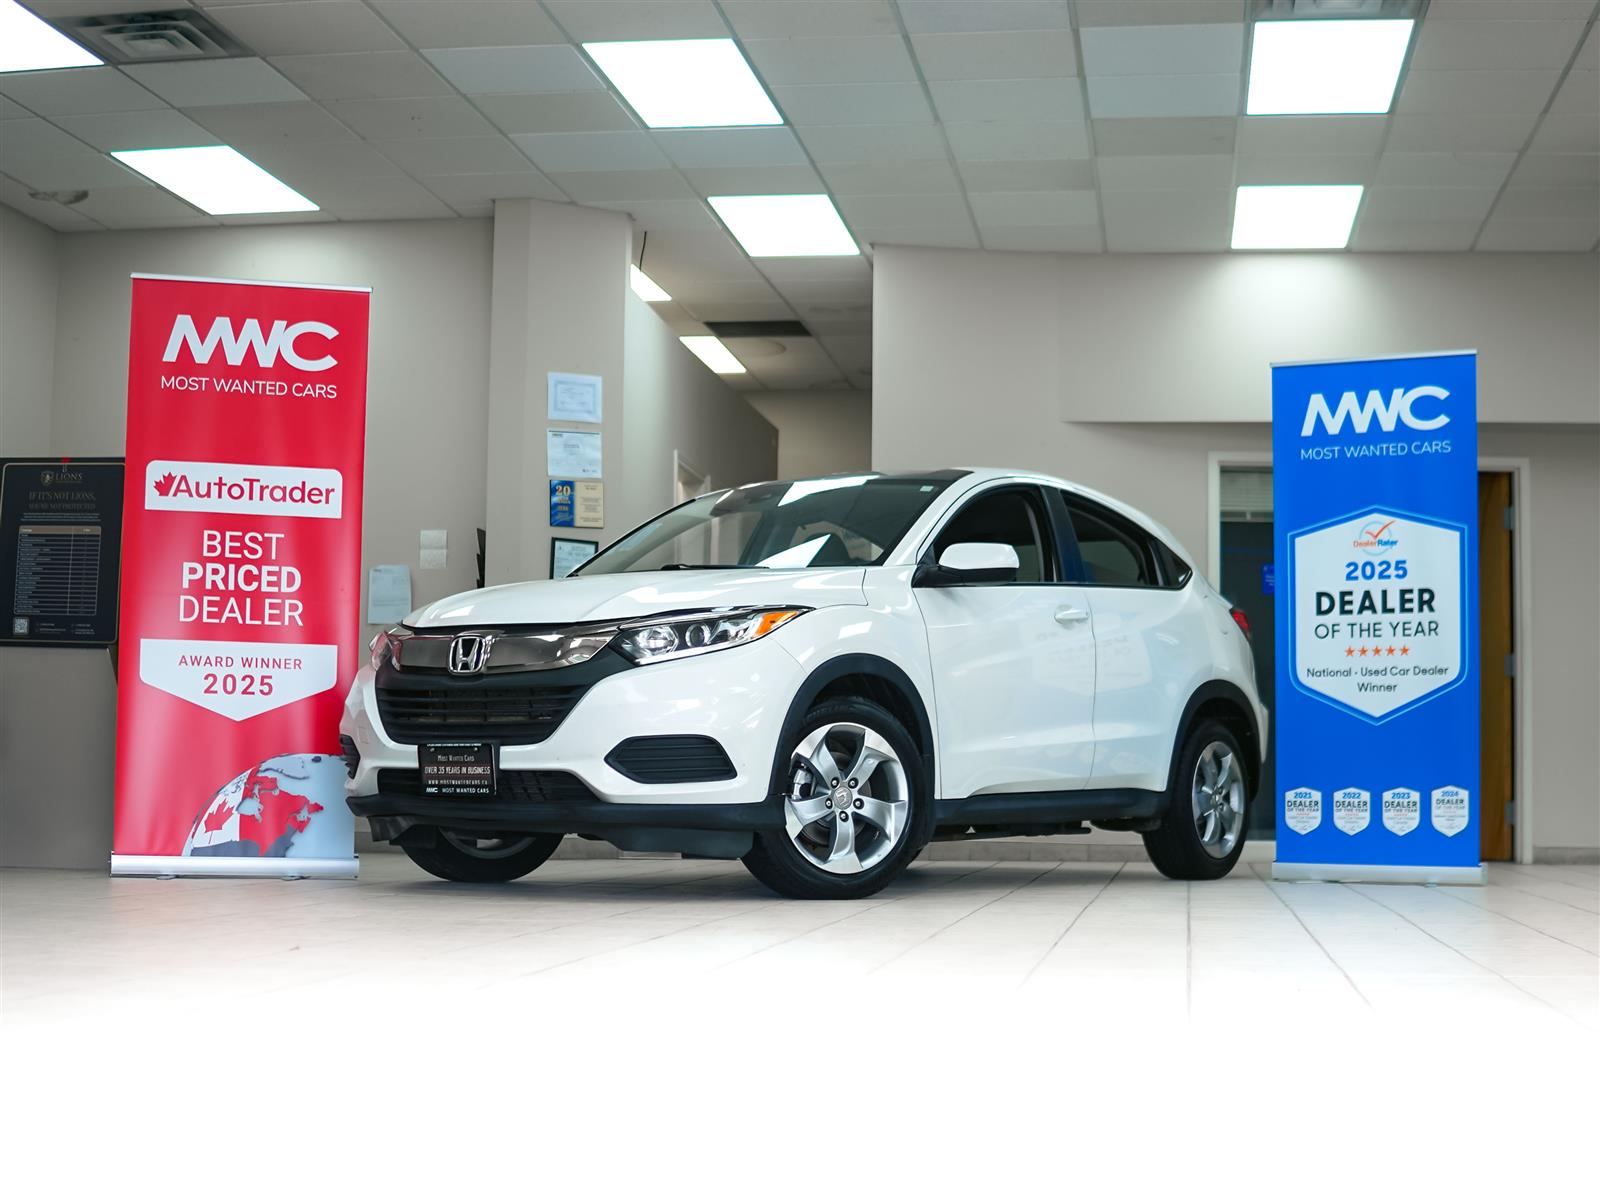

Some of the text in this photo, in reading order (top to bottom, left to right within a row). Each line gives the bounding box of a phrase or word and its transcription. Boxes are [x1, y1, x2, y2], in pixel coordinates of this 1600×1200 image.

[162, 314, 340, 372] MWC
[161, 376, 337, 398] MOST WANTED CARS
[1301, 385, 1451, 437] MWC
[1301, 440, 1451, 460] MOST WANTED CARS
[172, 474, 335, 505] AutoTrader
[202, 529, 285, 560] BEST
[182, 562, 301, 593] PRICED
[1345, 560, 1408, 581] 2025
[179, 595, 304, 627] DEALER
[1315, 588, 1435, 616] DEALER
[1314, 620, 1439, 640] OF THE YEAR
[178, 655, 303, 670] AWARD WINNER
[1306, 667, 1352, 678] National
[1360, 666, 1388, 677] Used
[1389, 665, 1410, 677] Car
[1412, 665, 1449, 676] Dealer
[203, 673, 274, 696] 2025
[1357, 682, 1398, 693] Winner
[424, 766, 491, 774] OVER 35 YEARS IN BUSINESS
[1287, 800, 1319, 808] DEALER
[1384, 801, 1418, 809] DEALER
